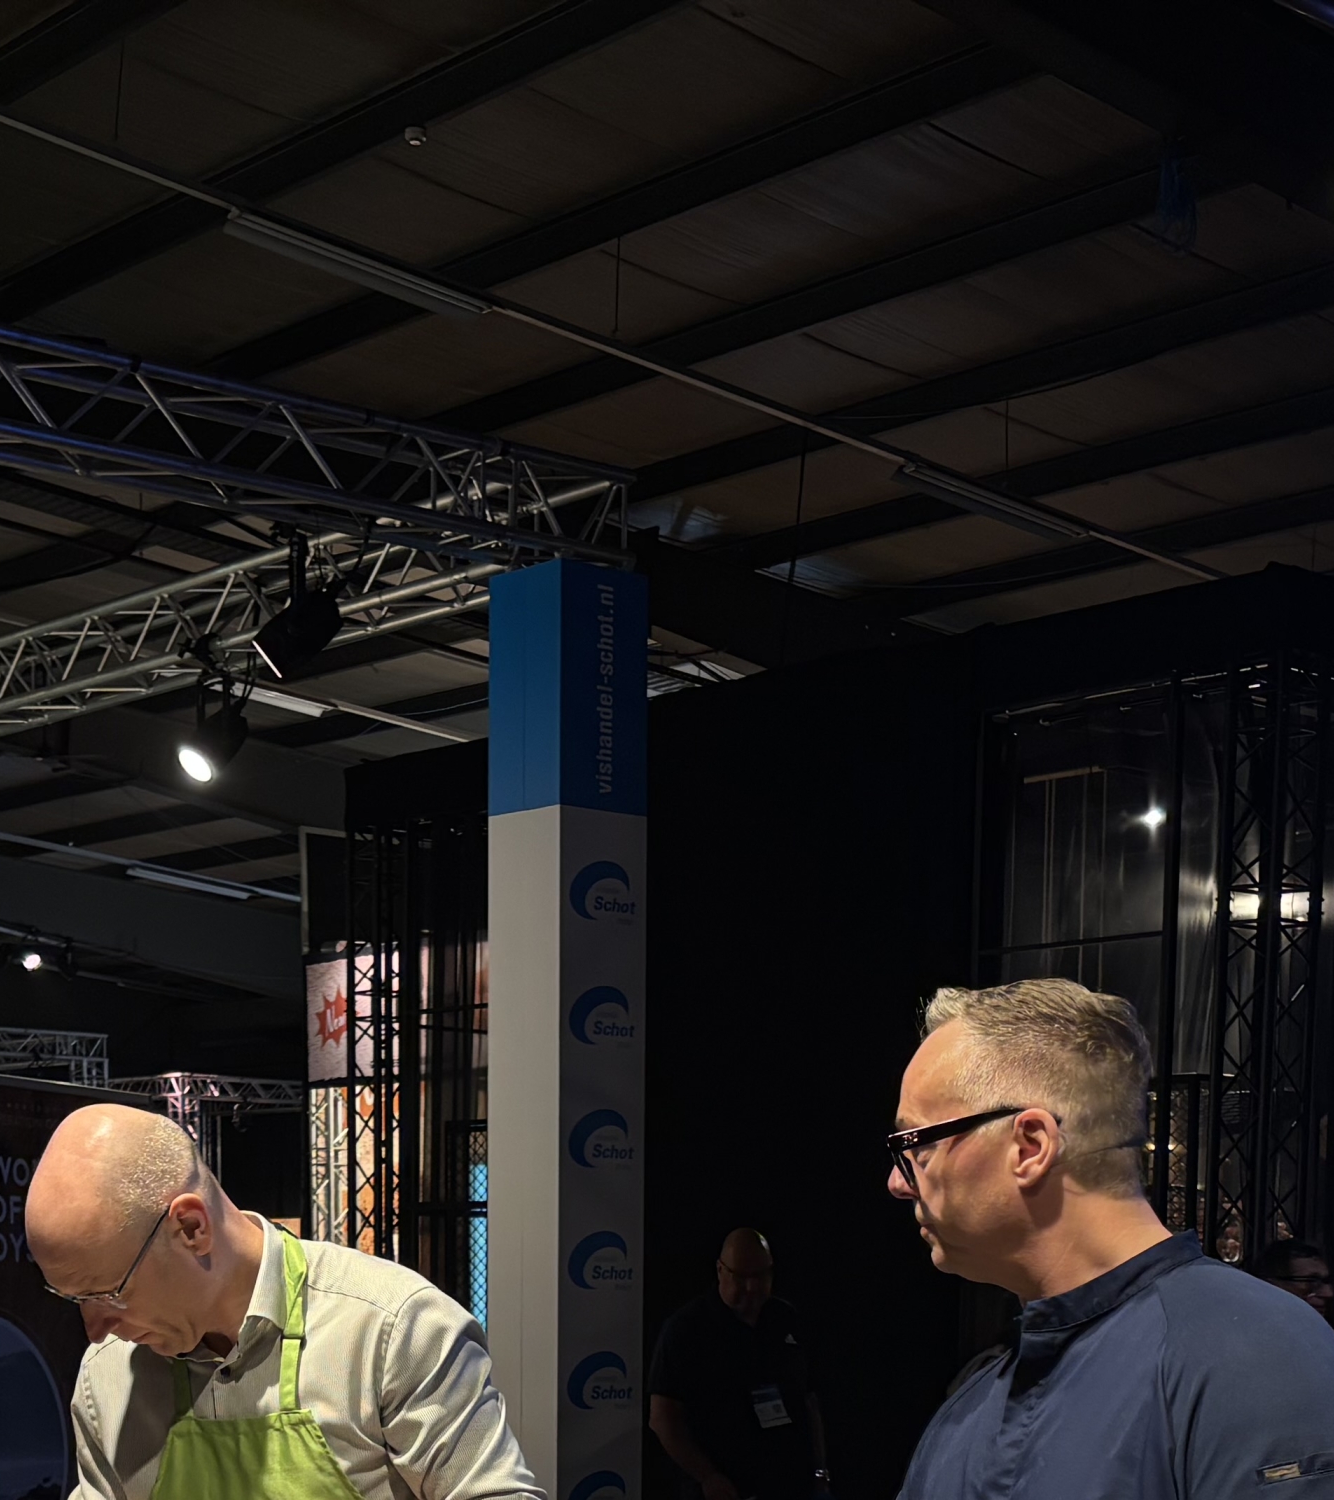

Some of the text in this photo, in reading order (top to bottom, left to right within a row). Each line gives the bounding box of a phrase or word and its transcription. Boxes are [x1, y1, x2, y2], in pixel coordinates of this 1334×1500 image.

[596, 583, 615, 795] vishandel-schot.nl
[593, 896, 636, 915] Schot
[593, 1020, 635, 1038] Schot
[592, 1143, 634, 1160] Schot
[591, 1265, 633, 1281] Schot
[591, 1385, 633, 1400] Schot
